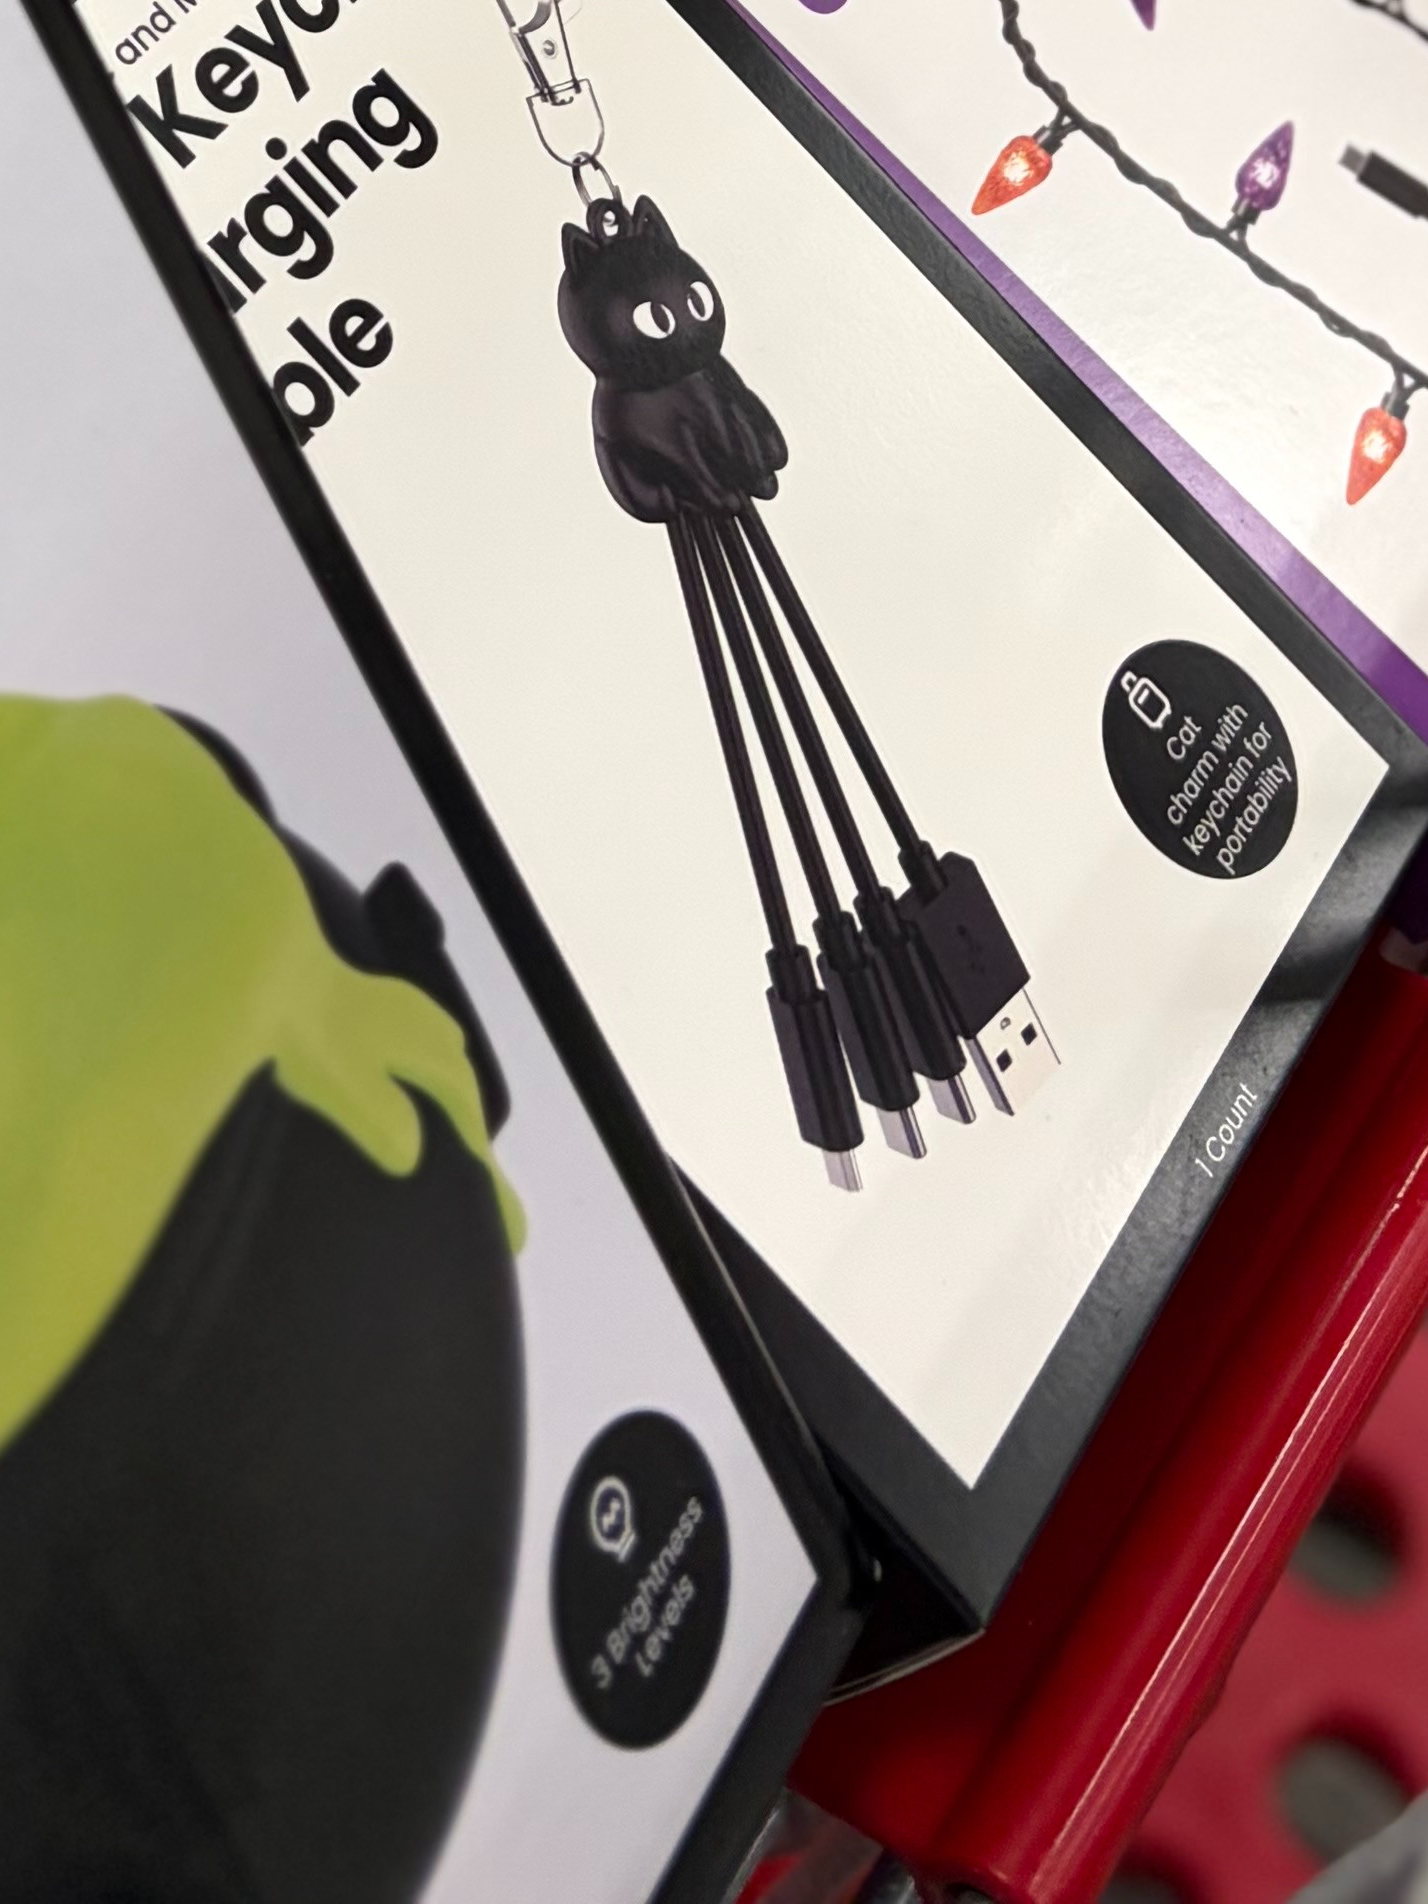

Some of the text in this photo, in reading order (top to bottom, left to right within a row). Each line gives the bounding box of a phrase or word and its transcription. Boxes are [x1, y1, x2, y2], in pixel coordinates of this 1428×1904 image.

[114, 2, 179, 68] and
[200, 66, 441, 314] rging
[274, 295, 396, 447] ble
[1165, 714, 1203, 762] Cat
[1165, 700, 1250, 827] charm with
[1181, 720, 1274, 857] keychain for
[1215, 754, 1293, 876] portability
[1205, 1082, 1258, 1163] Count
[591, 1496, 704, 1690] 3 Brightness
[636, 1574, 695, 1677] Levels
